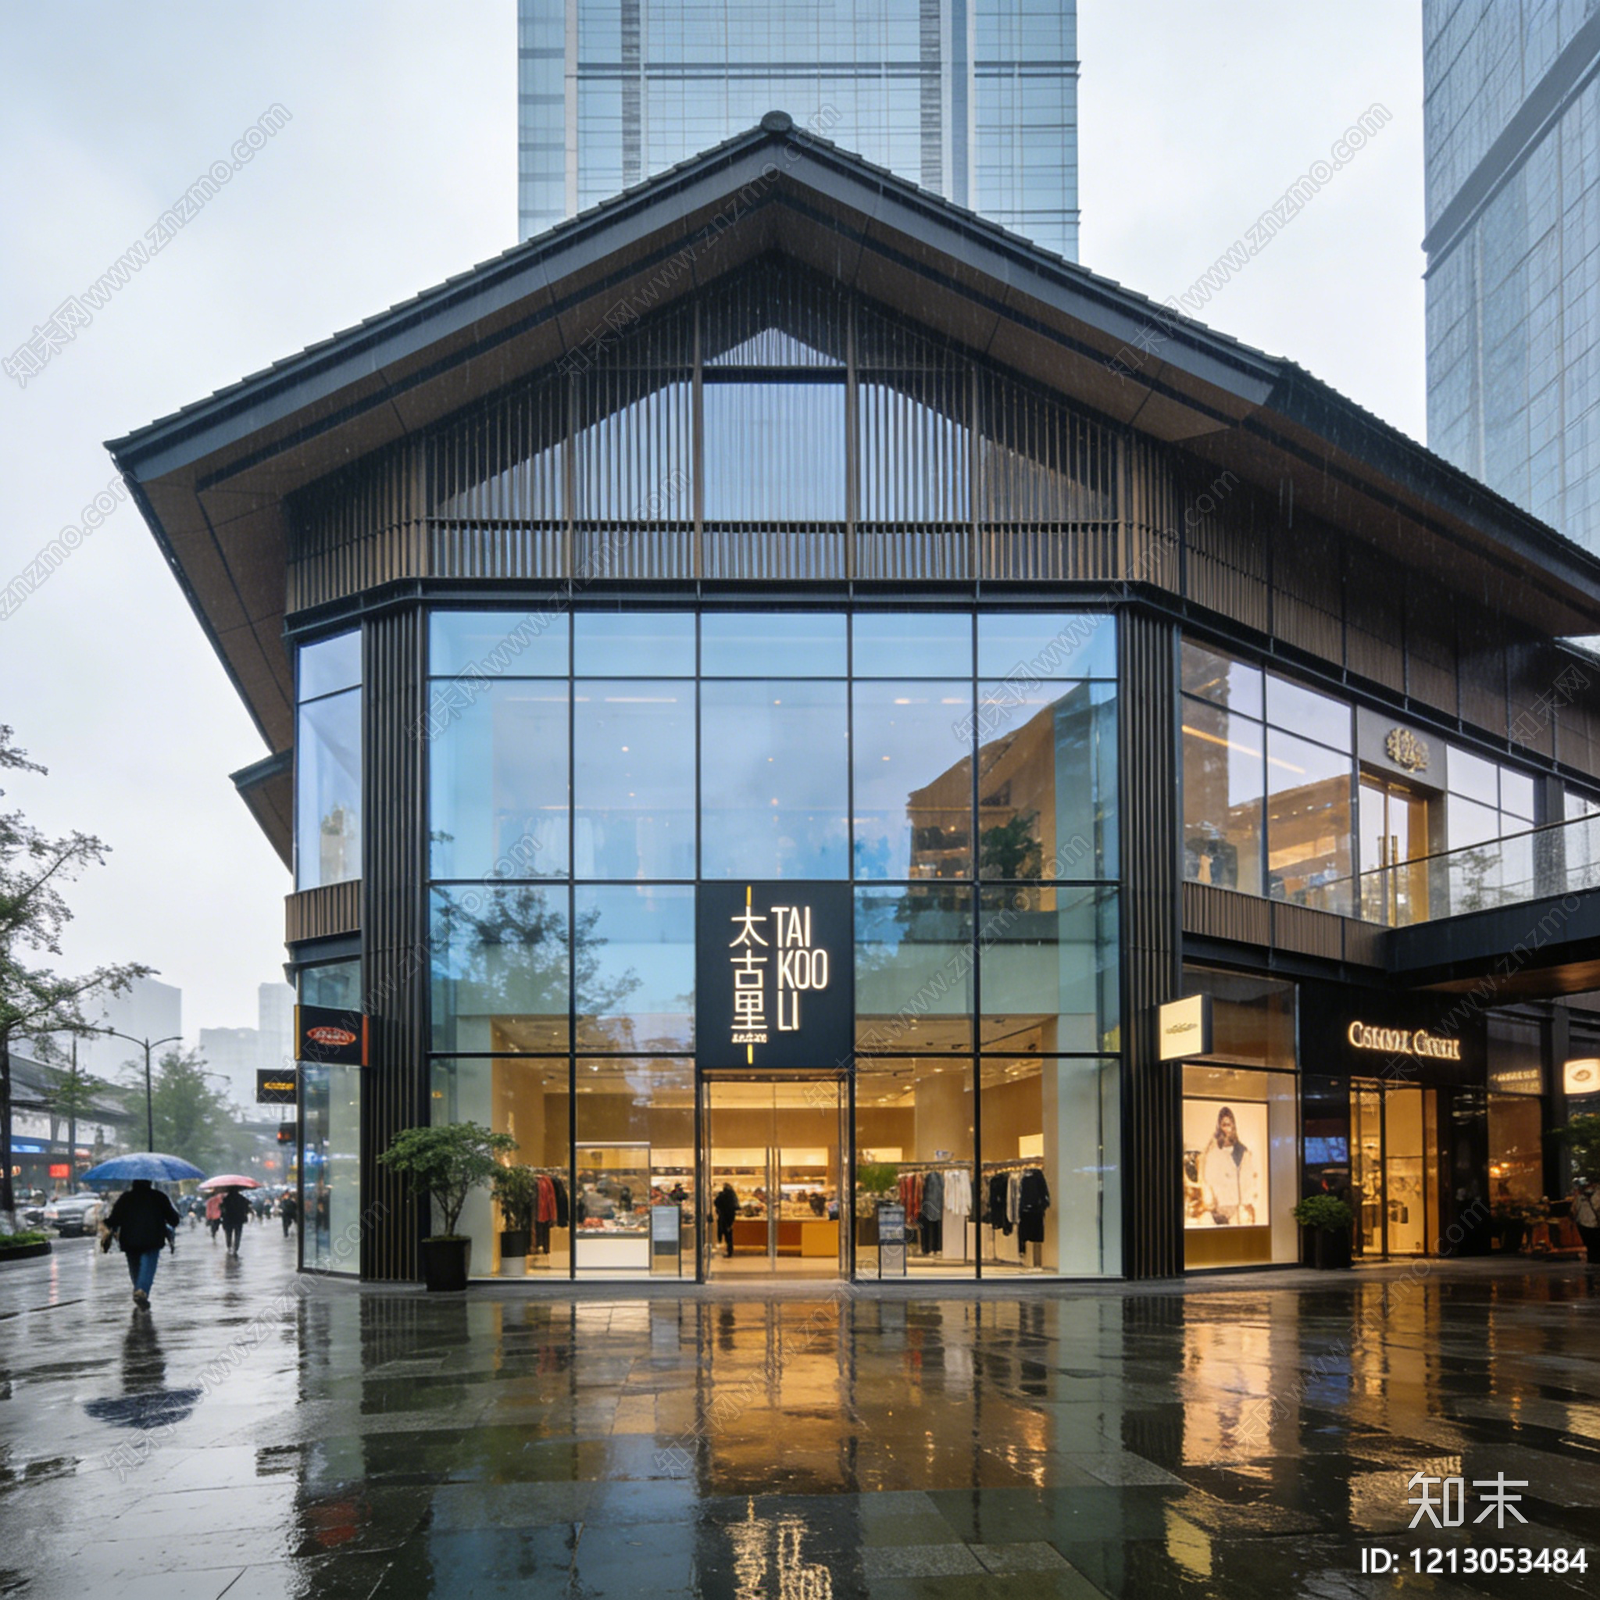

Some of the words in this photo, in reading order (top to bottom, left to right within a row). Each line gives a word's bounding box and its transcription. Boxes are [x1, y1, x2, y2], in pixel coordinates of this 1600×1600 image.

[771, 905, 811, 948] TAI
[729, 905, 769, 1030] 太古里
[777, 948, 828, 990] KOO
[777, 990, 799, 1031] LI
